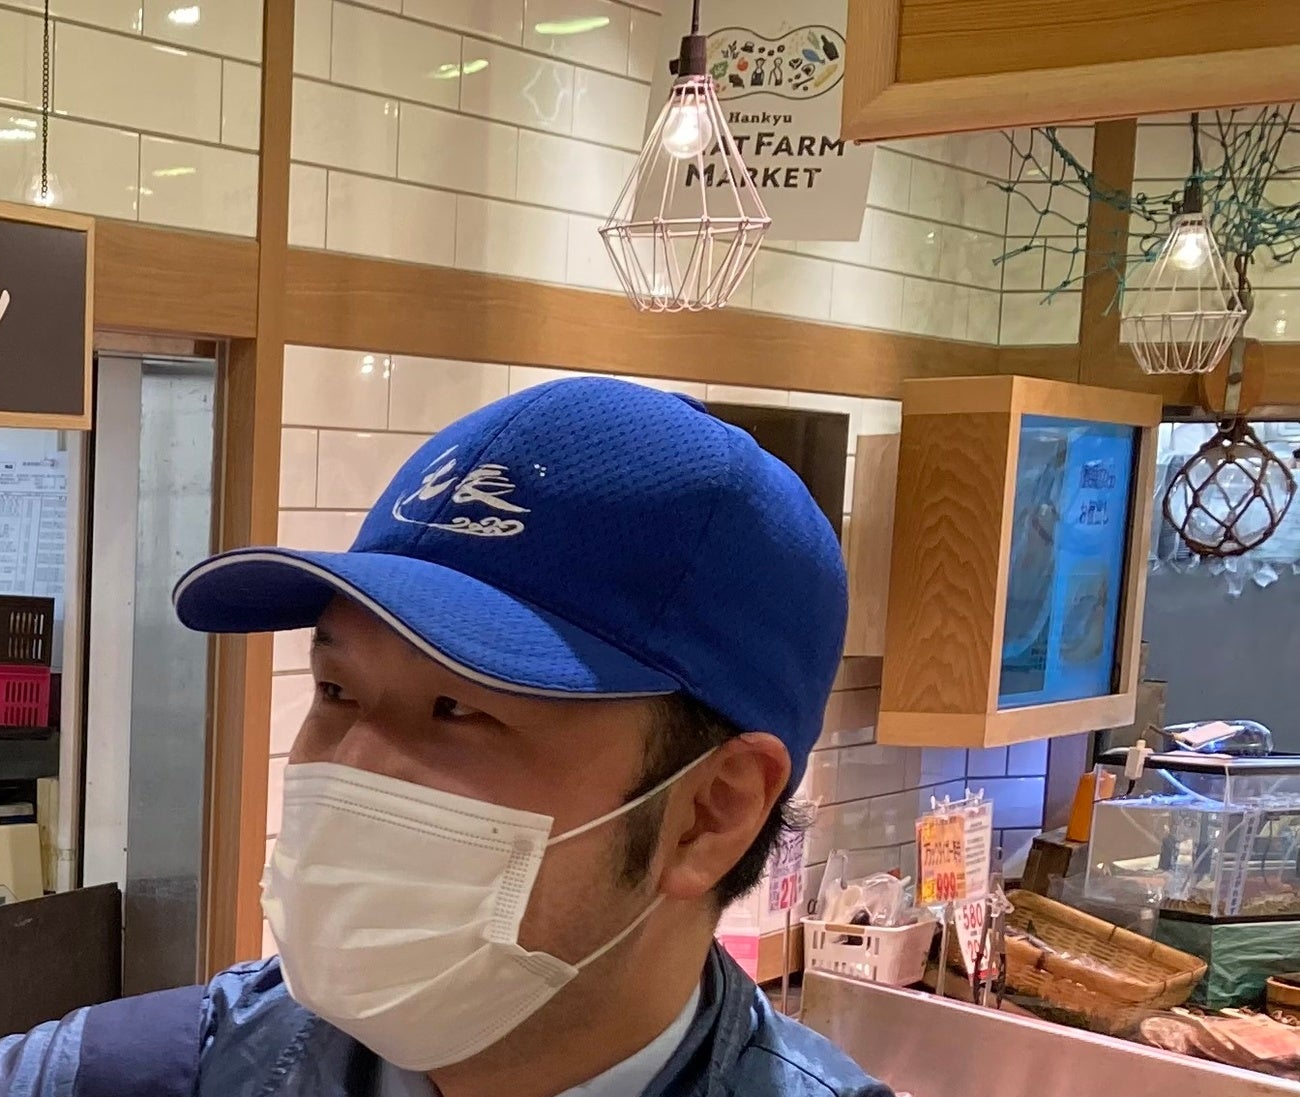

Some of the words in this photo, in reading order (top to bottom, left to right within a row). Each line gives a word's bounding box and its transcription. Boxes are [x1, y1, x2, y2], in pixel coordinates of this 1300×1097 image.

[728, 112, 792, 126] Hankyu
[685, 163, 822, 189] MARKET
[963, 903, 983, 930] 580
